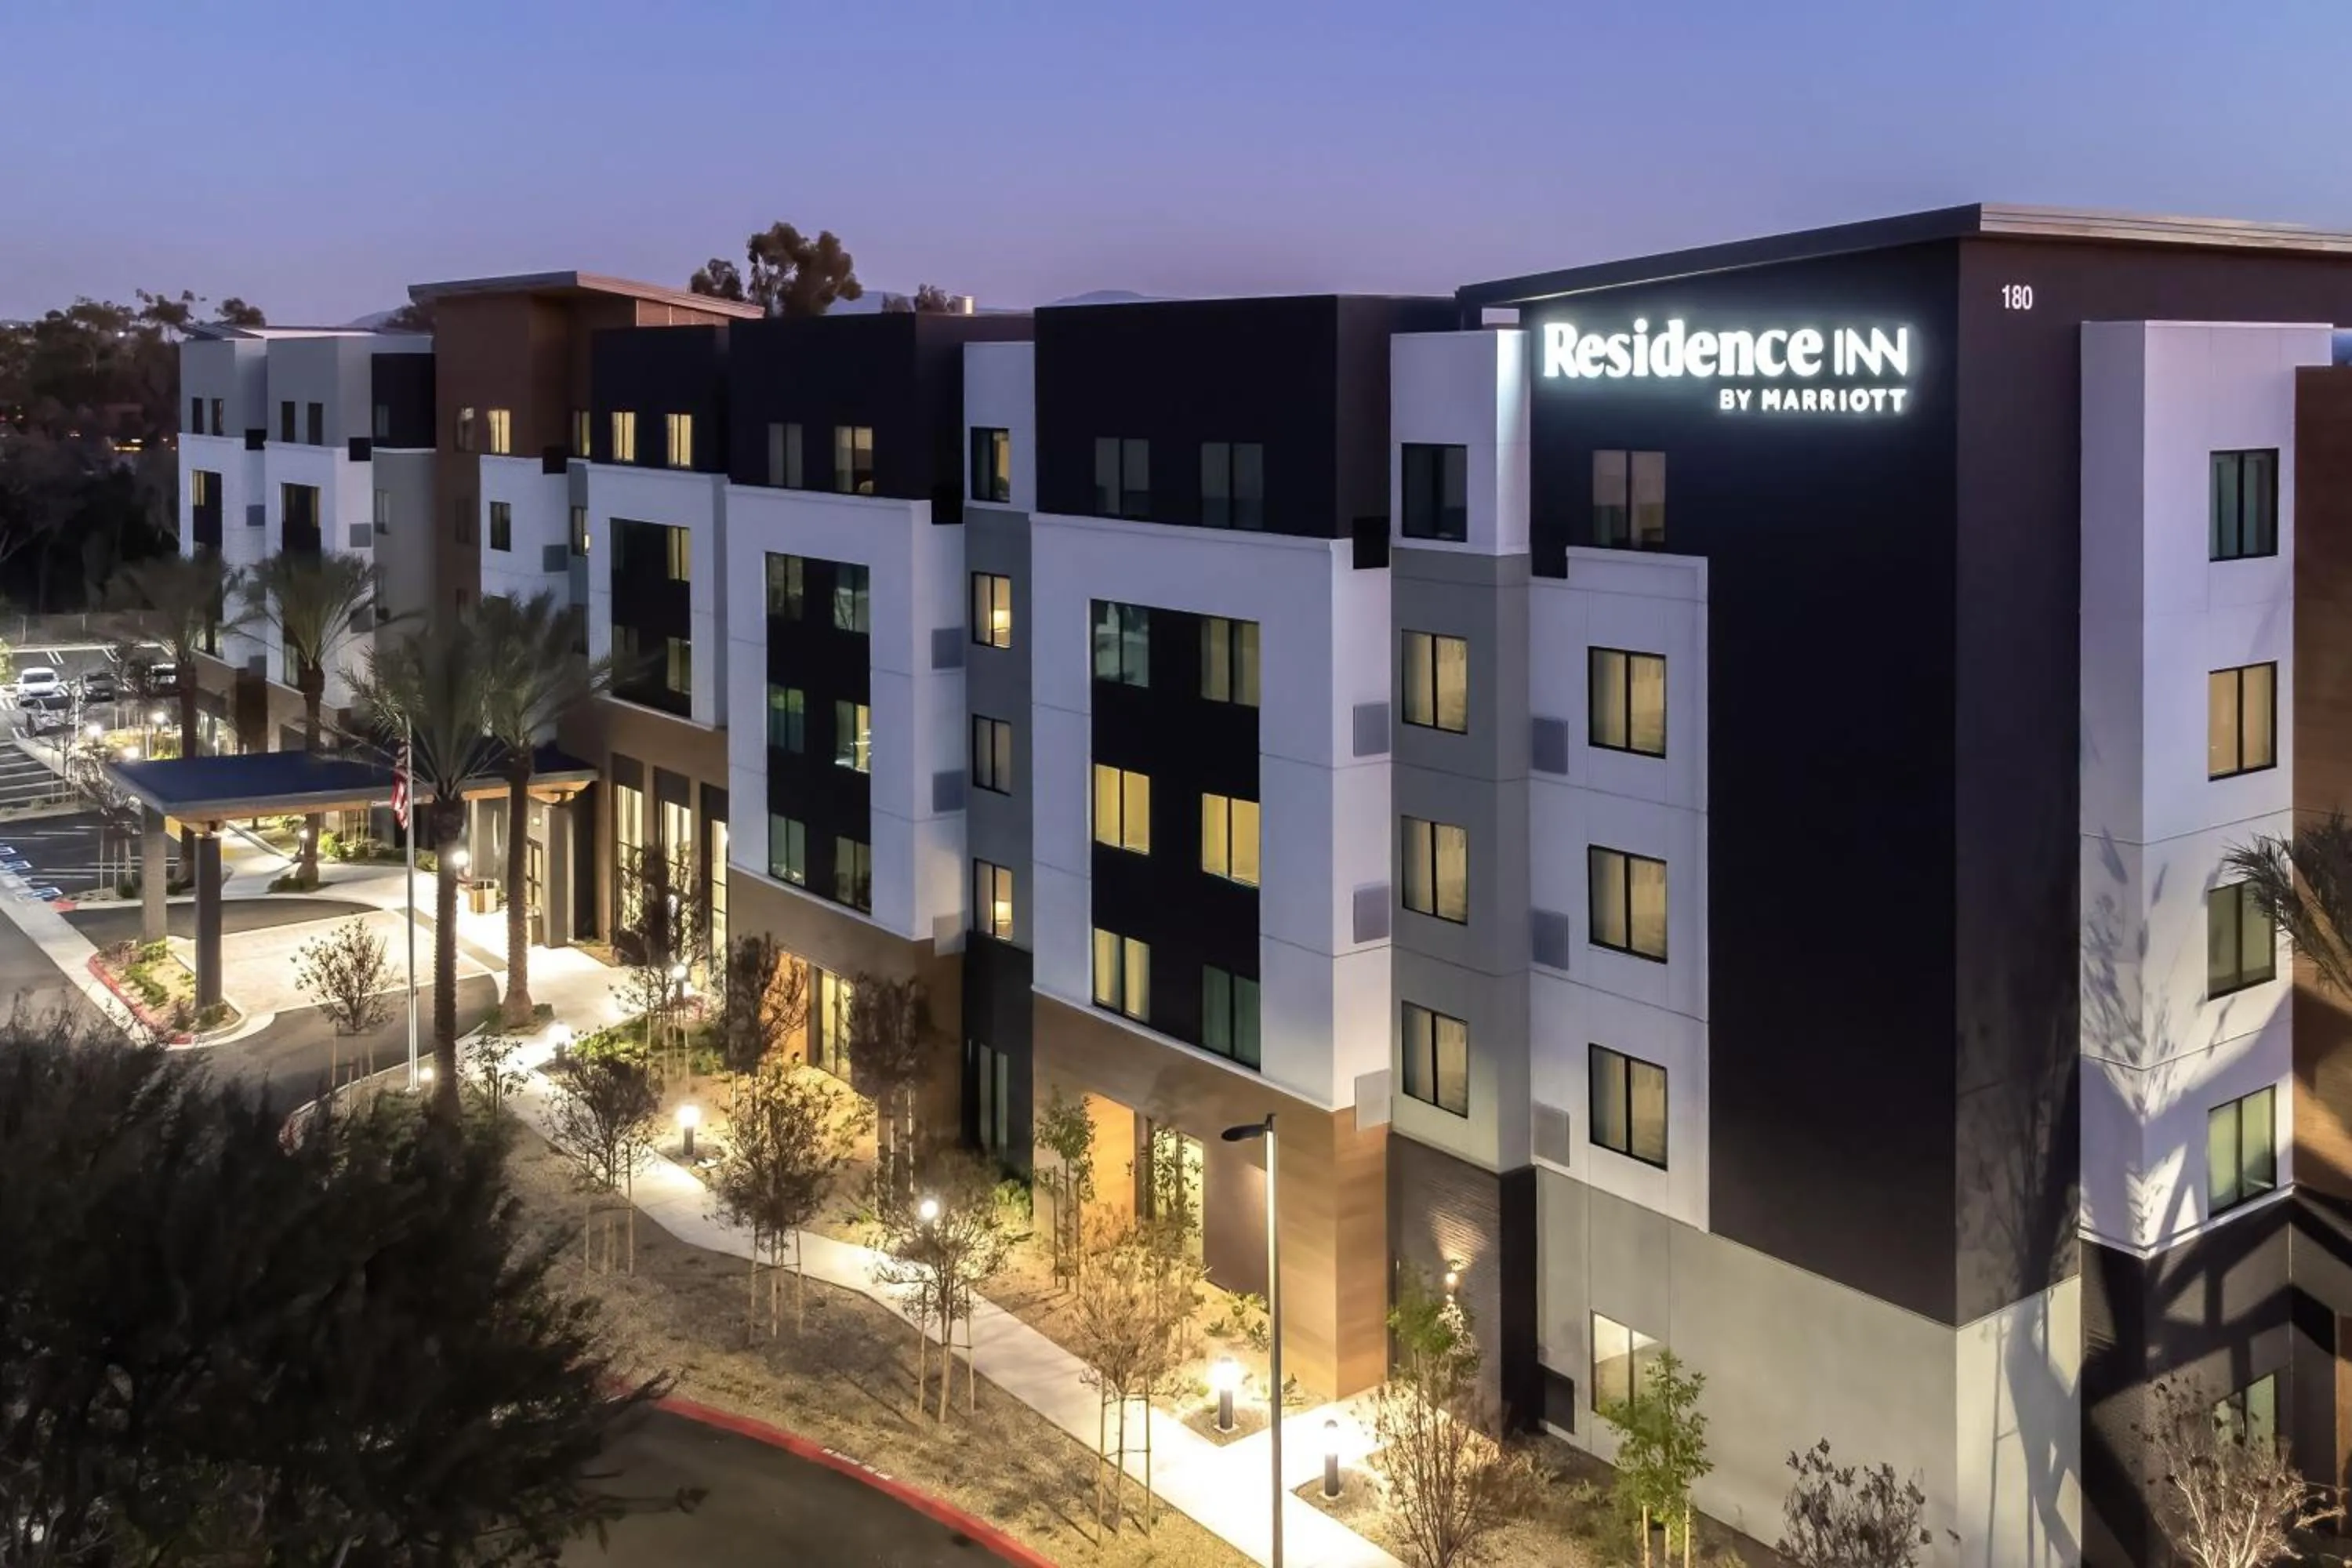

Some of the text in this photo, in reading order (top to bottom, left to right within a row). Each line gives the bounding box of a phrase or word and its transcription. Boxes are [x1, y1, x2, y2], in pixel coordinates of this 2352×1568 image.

[2002, 285, 2033, 310] 180
[1543, 318, 1908, 379] Residence INN
[1719, 388, 1907, 412] BY MARRIOTT
